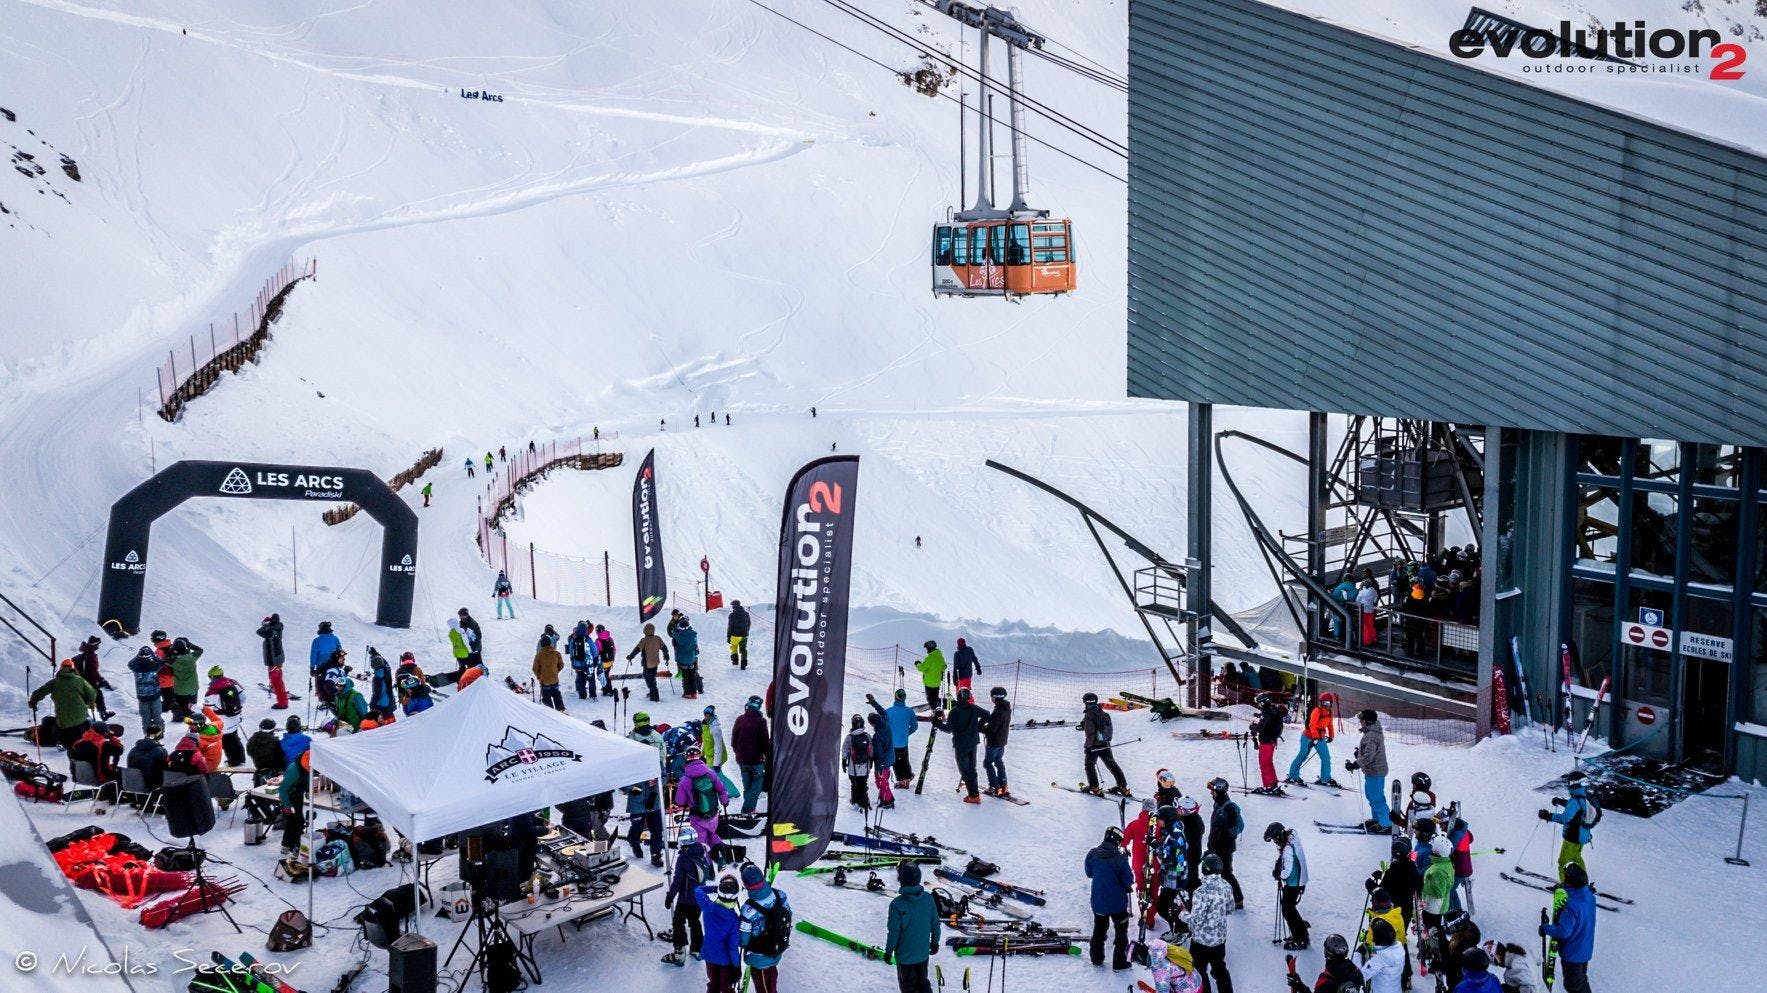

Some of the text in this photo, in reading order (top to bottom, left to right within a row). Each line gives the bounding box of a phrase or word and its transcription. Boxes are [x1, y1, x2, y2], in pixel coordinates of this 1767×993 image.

[482, 90, 503, 103] Arcs
[257, 472, 344, 490] LES ARCS
[304, 489, 342, 499] Paradiski
[111, 562, 126, 570] LES
[390, 564, 403, 572] LES
[816, 521, 834, 676] outdoor specialist
[1689, 636, 1726, 649] RESERVE
[1682, 645, 1732, 659] ECOLES DE SKI
[491, 757, 518, 774] ARC
[504, 760, 567, 780] LE VILLAGE
